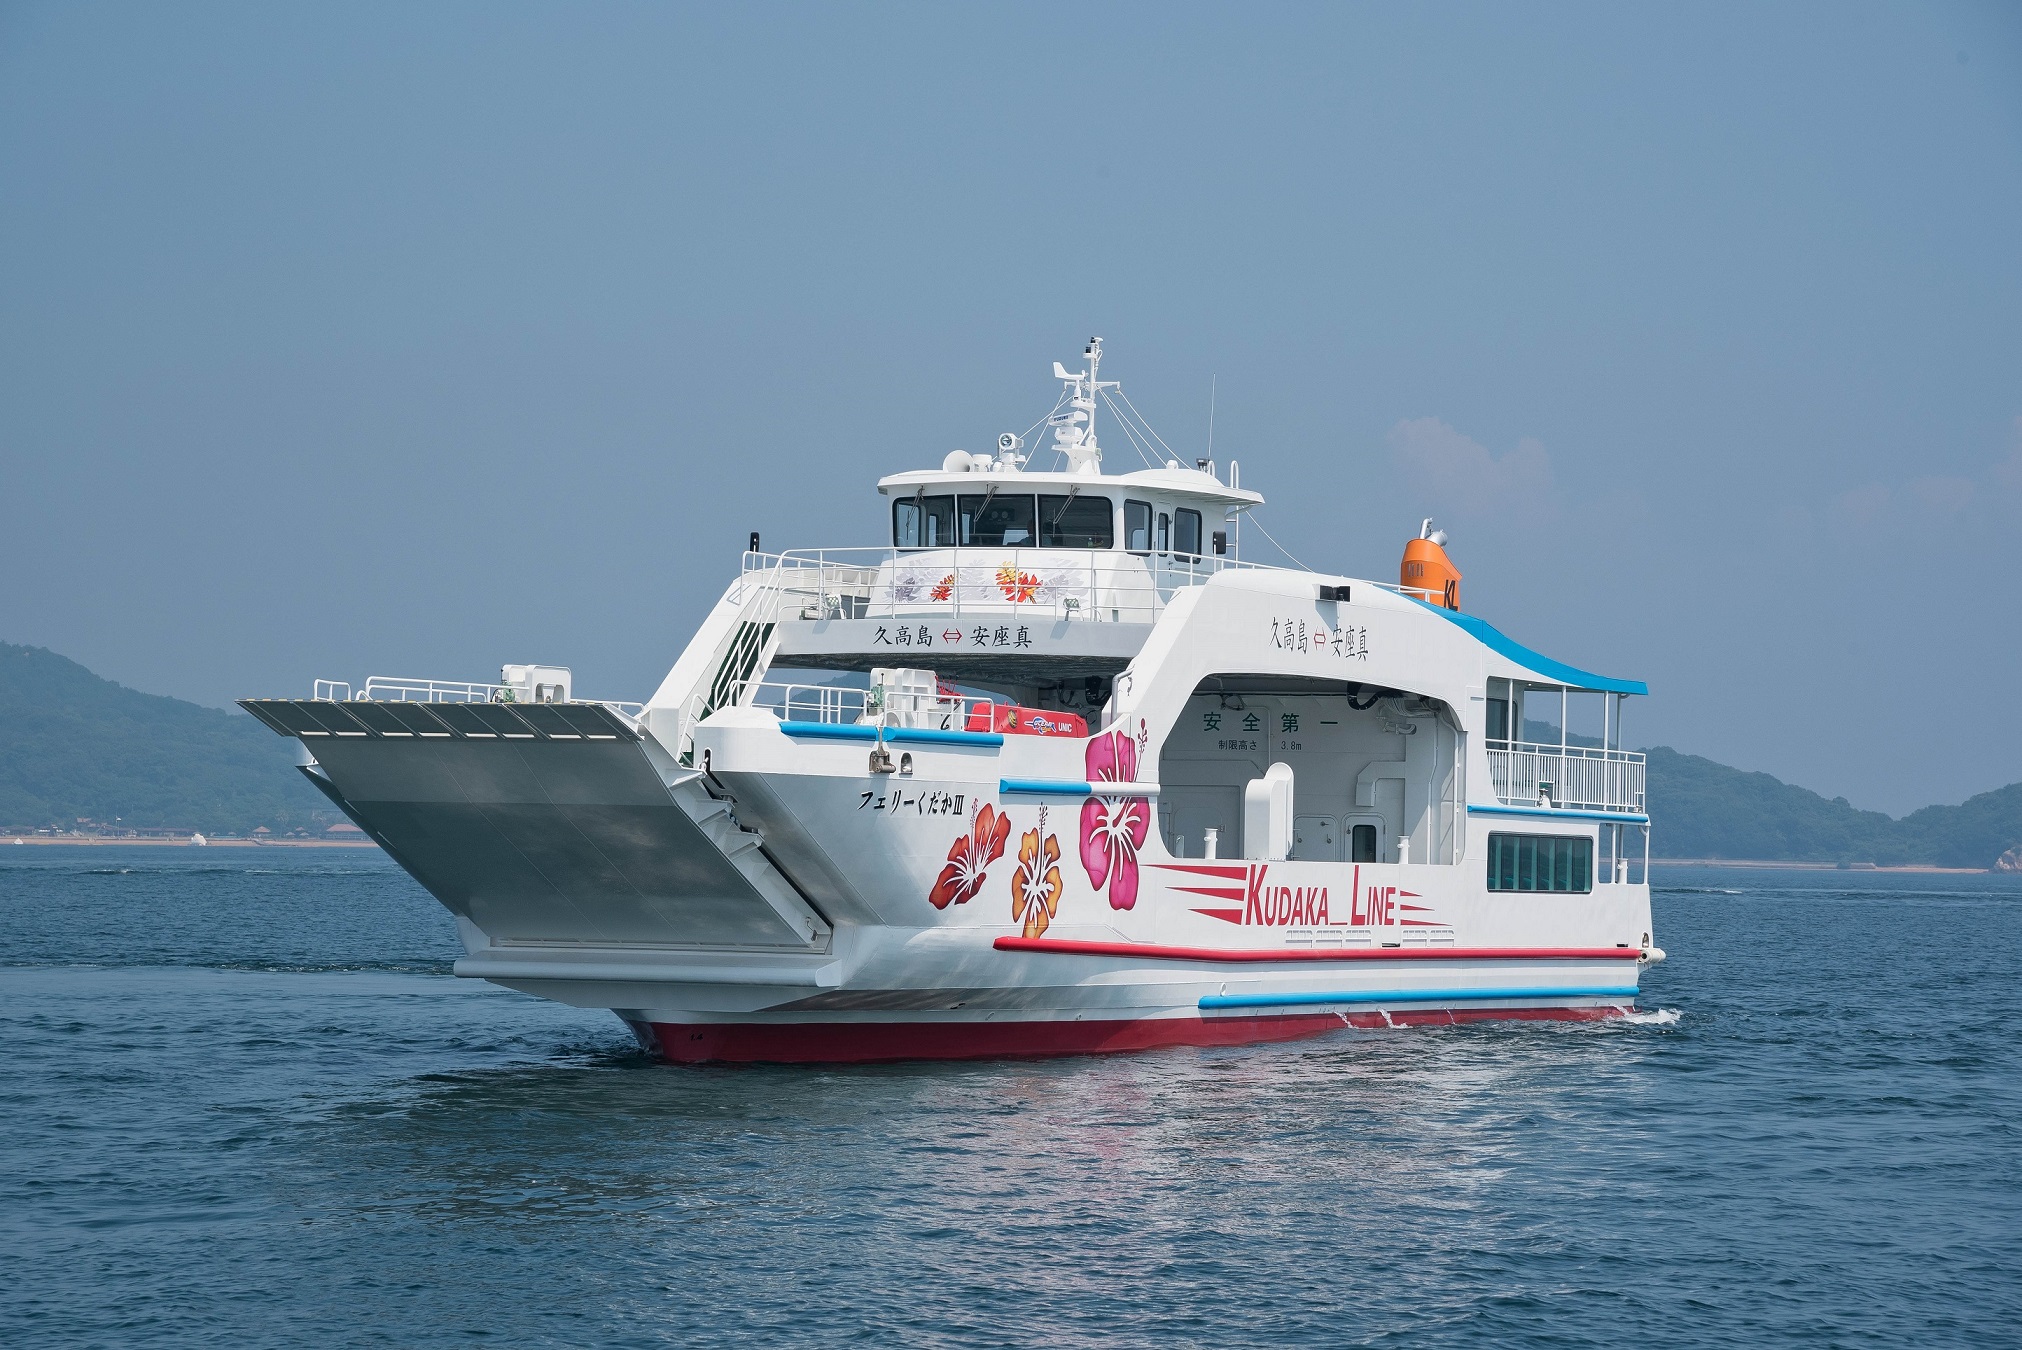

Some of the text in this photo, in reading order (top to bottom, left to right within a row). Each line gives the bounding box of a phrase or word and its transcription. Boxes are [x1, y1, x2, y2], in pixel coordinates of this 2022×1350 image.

[1443, 579, 1459, 611] KL
[873, 625, 1032, 649] 久高島 安座真
[1269, 616, 1369, 662] 久高島 安座真
[1203, 711, 1338, 733] 安全第一
[1218, 739, 1302, 751] 制限高さ 3.8m
[1245, 863, 1397, 927] KUDAKA LINE
